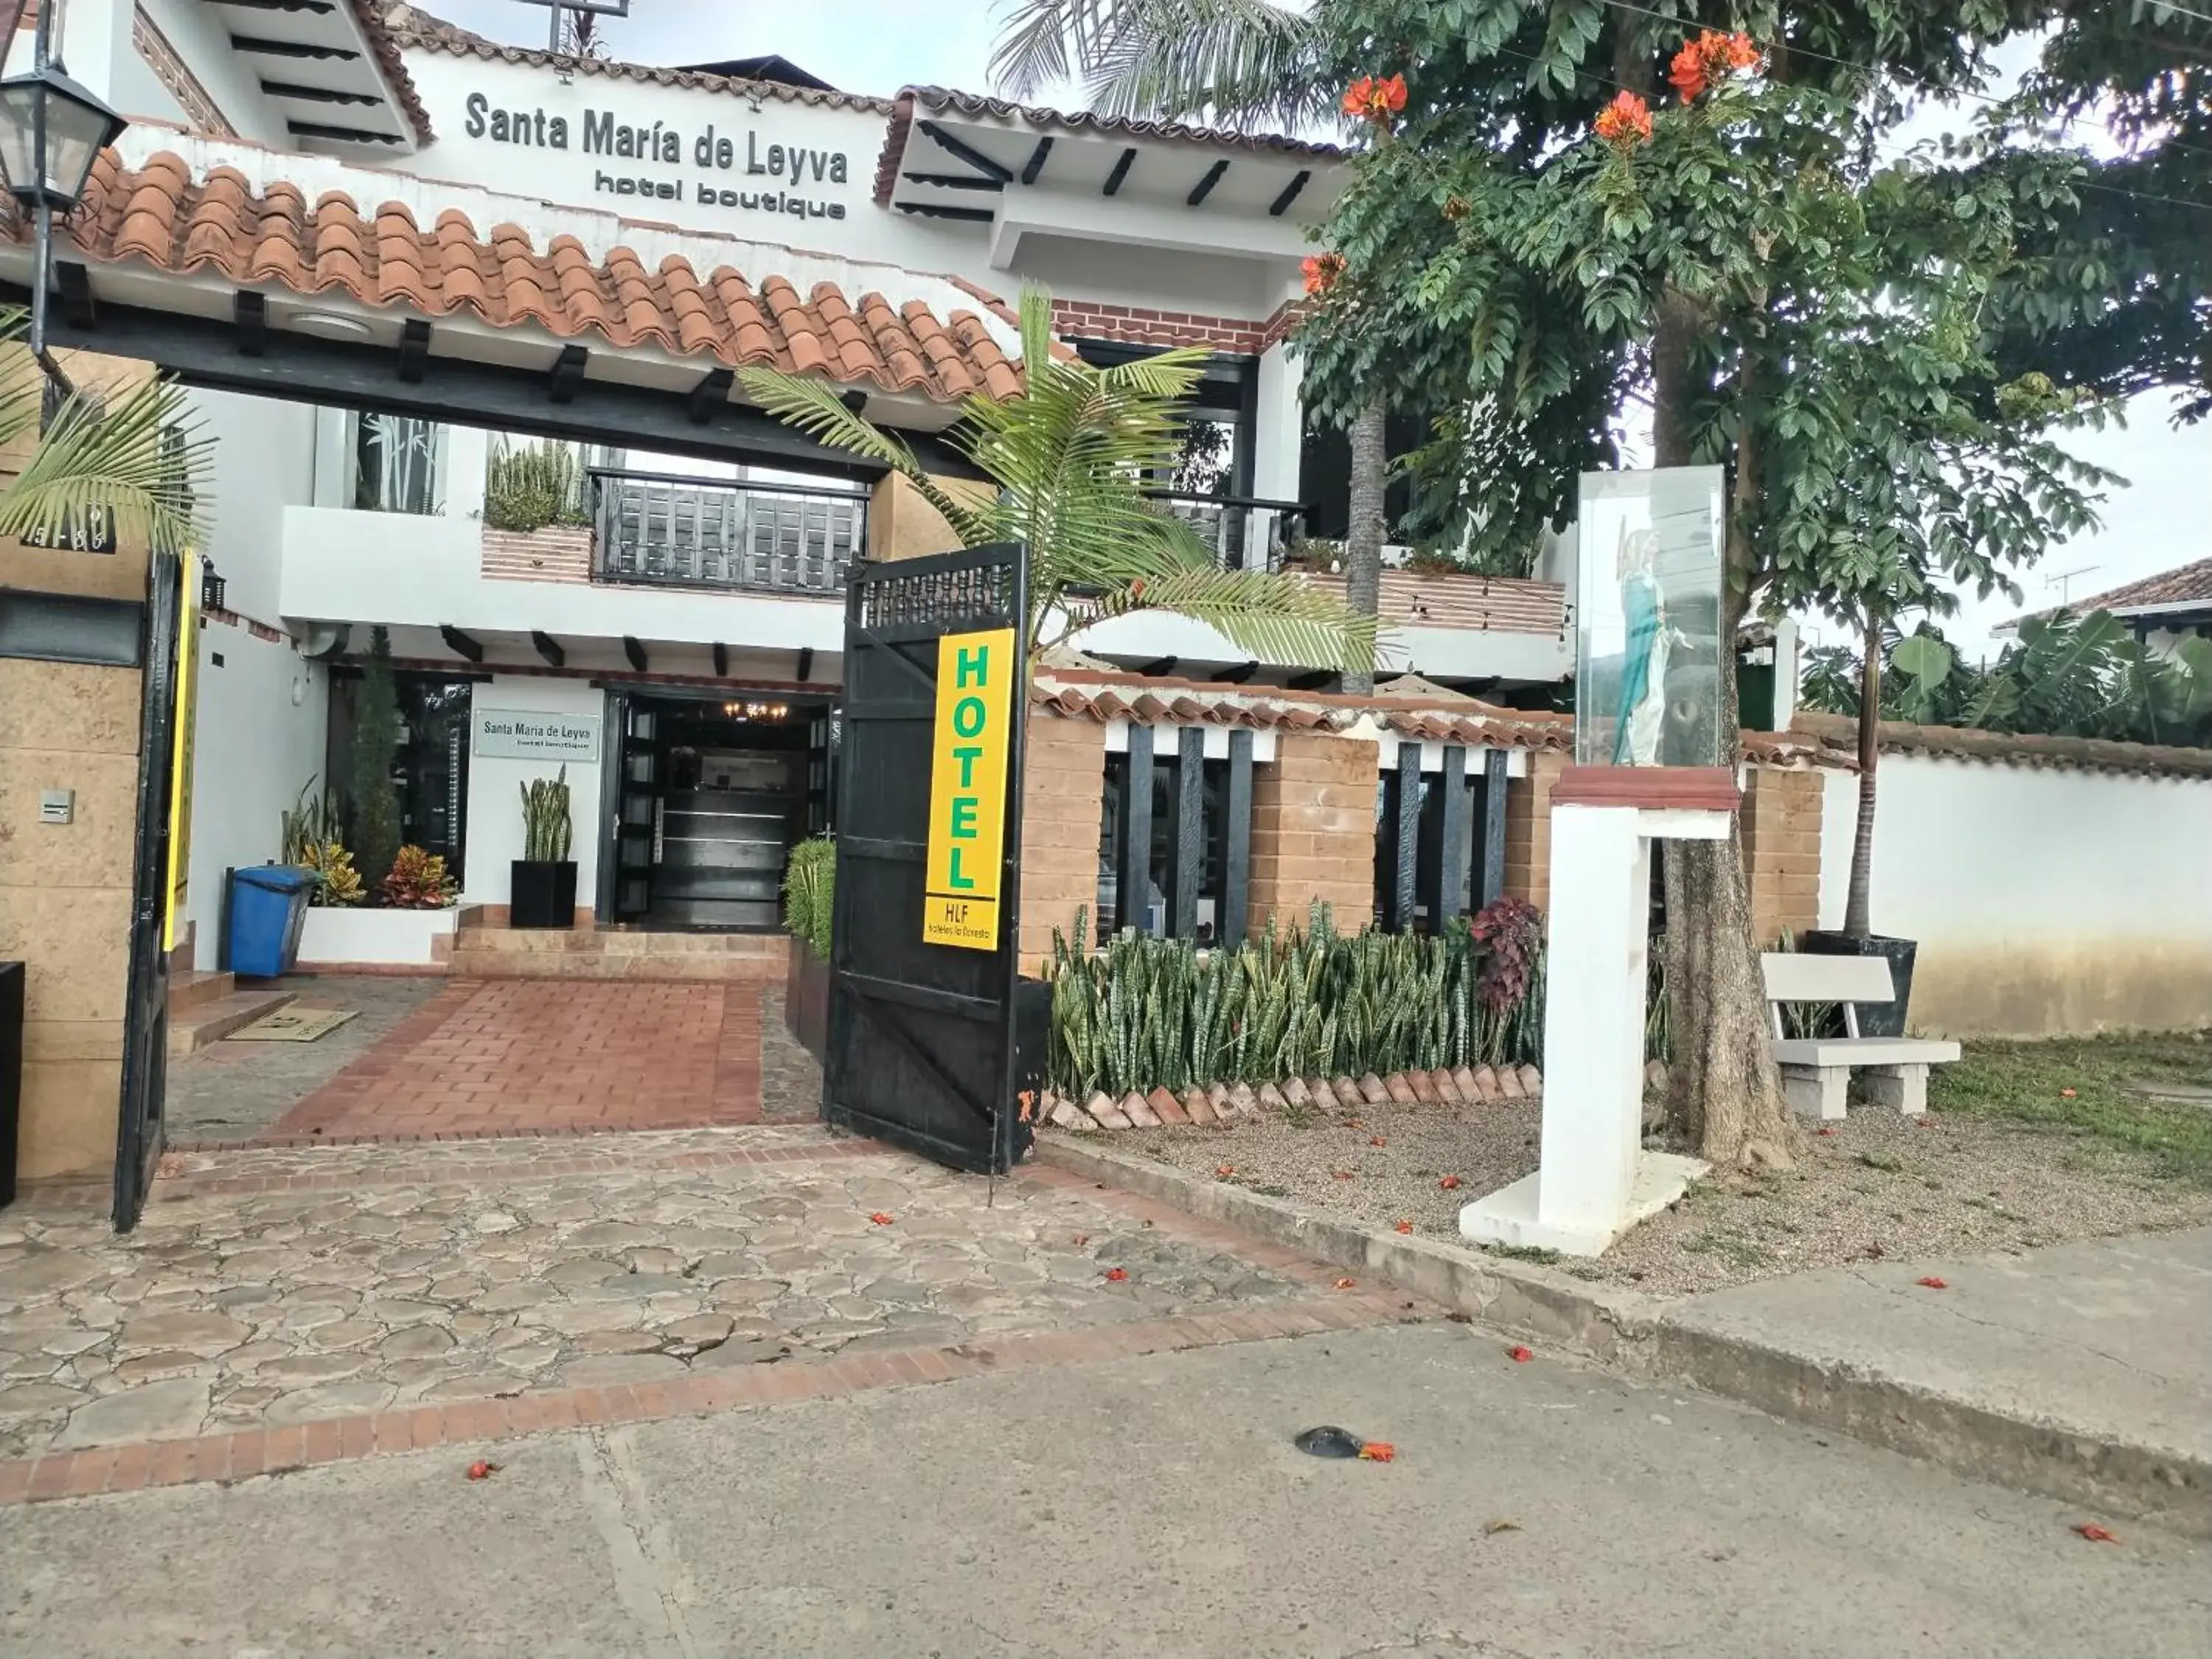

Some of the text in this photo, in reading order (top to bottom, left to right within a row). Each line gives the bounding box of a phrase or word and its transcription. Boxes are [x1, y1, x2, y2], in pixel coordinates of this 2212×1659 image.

[465, 92, 847, 186] Santa María de Leyva
[594, 170, 846, 220] hotel boutique
[484, 720, 512, 735] Santa
[546, 726, 558, 737] de
[561, 725, 590, 740] Leyva
[949, 645, 989, 888] HOTEL
[945, 902, 968, 923] HLF
